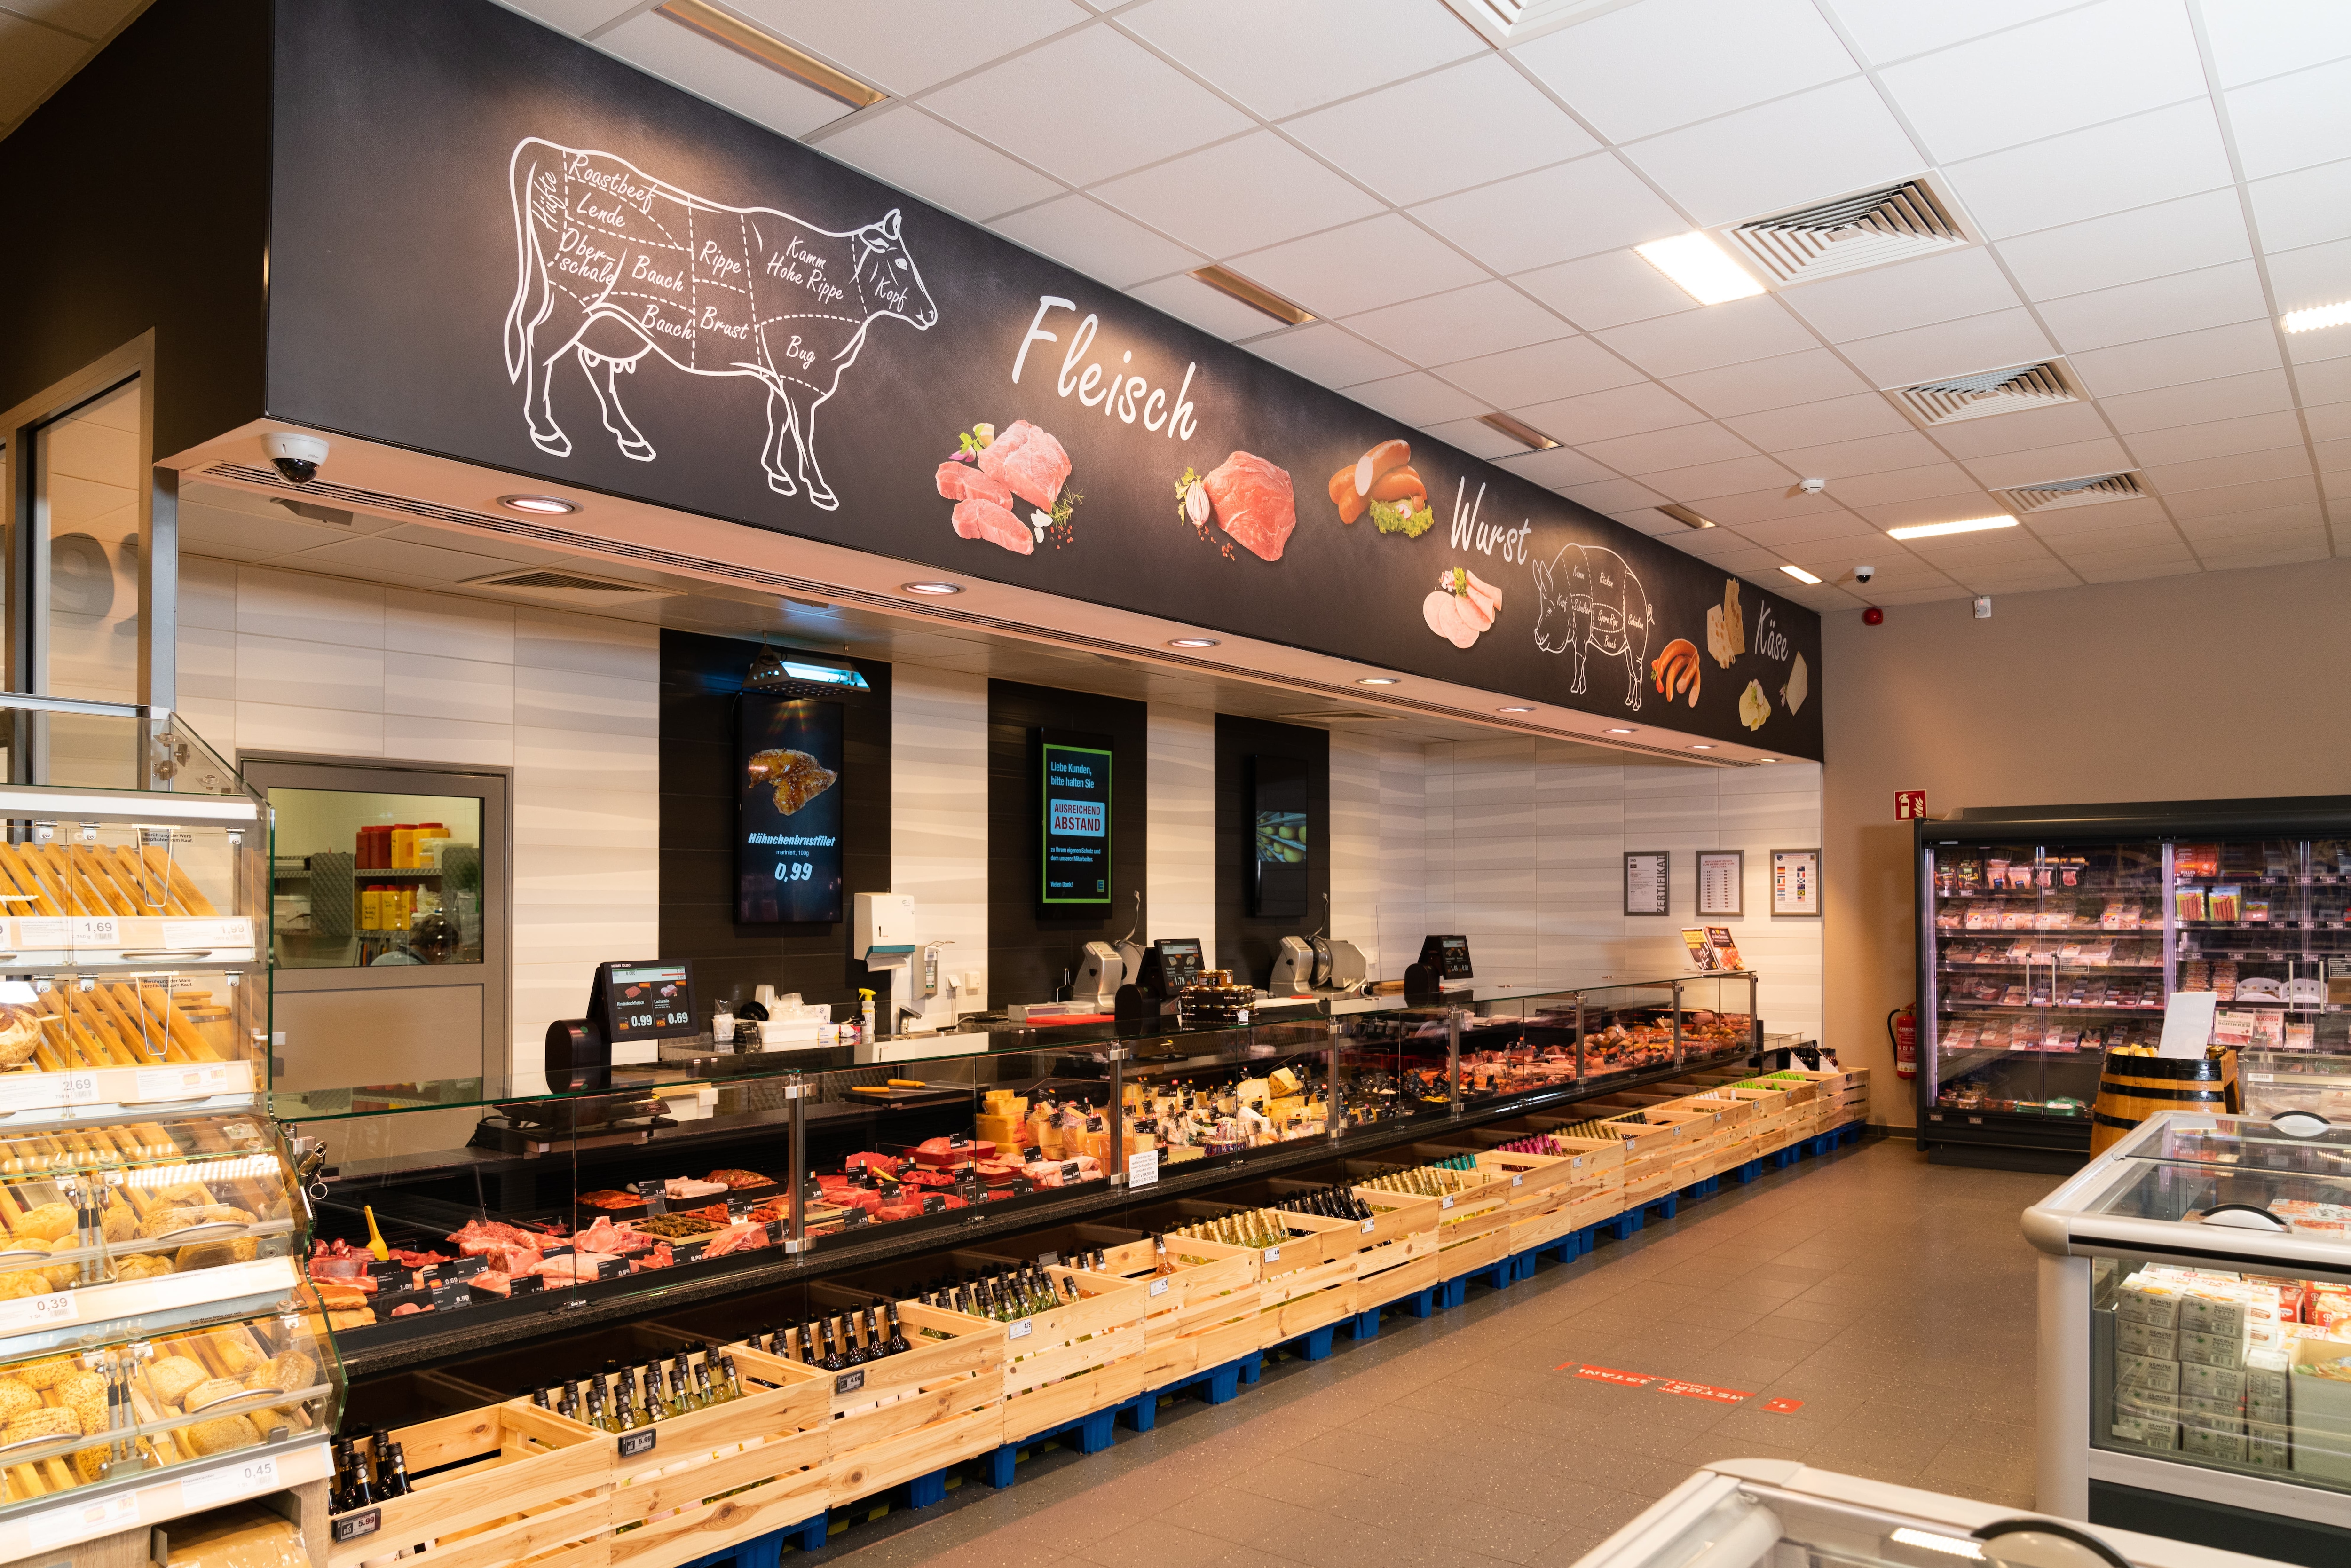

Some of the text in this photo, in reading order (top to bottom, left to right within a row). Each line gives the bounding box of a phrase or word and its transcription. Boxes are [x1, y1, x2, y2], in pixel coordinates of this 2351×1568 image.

[569, 154, 658, 215] Roastbeef
[532, 172, 566, 232] Hüfte
[577, 192, 625, 227] Lende
[562, 228, 615, 261] Ober-
[786, 236, 825, 269] Kamm
[699, 240, 741, 274] Rippe
[560, 258, 615, 285] schale
[632, 255, 684, 291] Bauch
[767, 252, 844, 300] Hohe Rippe
[874, 276, 907, 312] Kopf
[641, 304, 694, 341] Bauch
[700, 307, 748, 340] Brust
[786, 336, 816, 369] Bug
[1011, 295, 1197, 441] Fleisch
[1451, 476, 1531, 565] Wurst
[1573, 564, 1585, 580] Kamm
[1599, 572, 1613, 588] Rücken
[1556, 593, 1568, 612] Kopf
[1573, 599, 1591, 615] Schulter
[1598, 610, 1618, 630] Spare Rips
[1628, 614, 1643, 630] Schinken
[1754, 599, 1788, 662] Käse
[1604, 635, 1616, 649] Bauch
[1051, 761, 1092, 776] Liebe Kunden,
[1051, 776, 1095, 788] bitte halten Sie
[1054, 804, 1101, 815] AUSREICHEND
[1054, 816, 1101, 832] ABSTAND
[748, 832, 836, 847] Hähnchenbrustfilet
[774, 862, 813, 882] 0,99
[1657, 856, 1665, 912] ZERTIFIKAT
[85, 922, 112, 933] 1,69
[220, 924, 245, 935] 1,99
[1174, 977, 1185, 985] 1.79
[631, 1015, 652, 1027] 0.99
[668, 1012, 688, 1024] 0.69
[63, 1079, 91, 1092] 2,69
[37, 1298, 68, 1311] 0,39
[638, 1435, 651, 1444] 5.99
[245, 1463, 271, 1479] 0,45
[358, 1516, 375, 1527] 5.99
[343, 1525, 352, 1535] BIO
